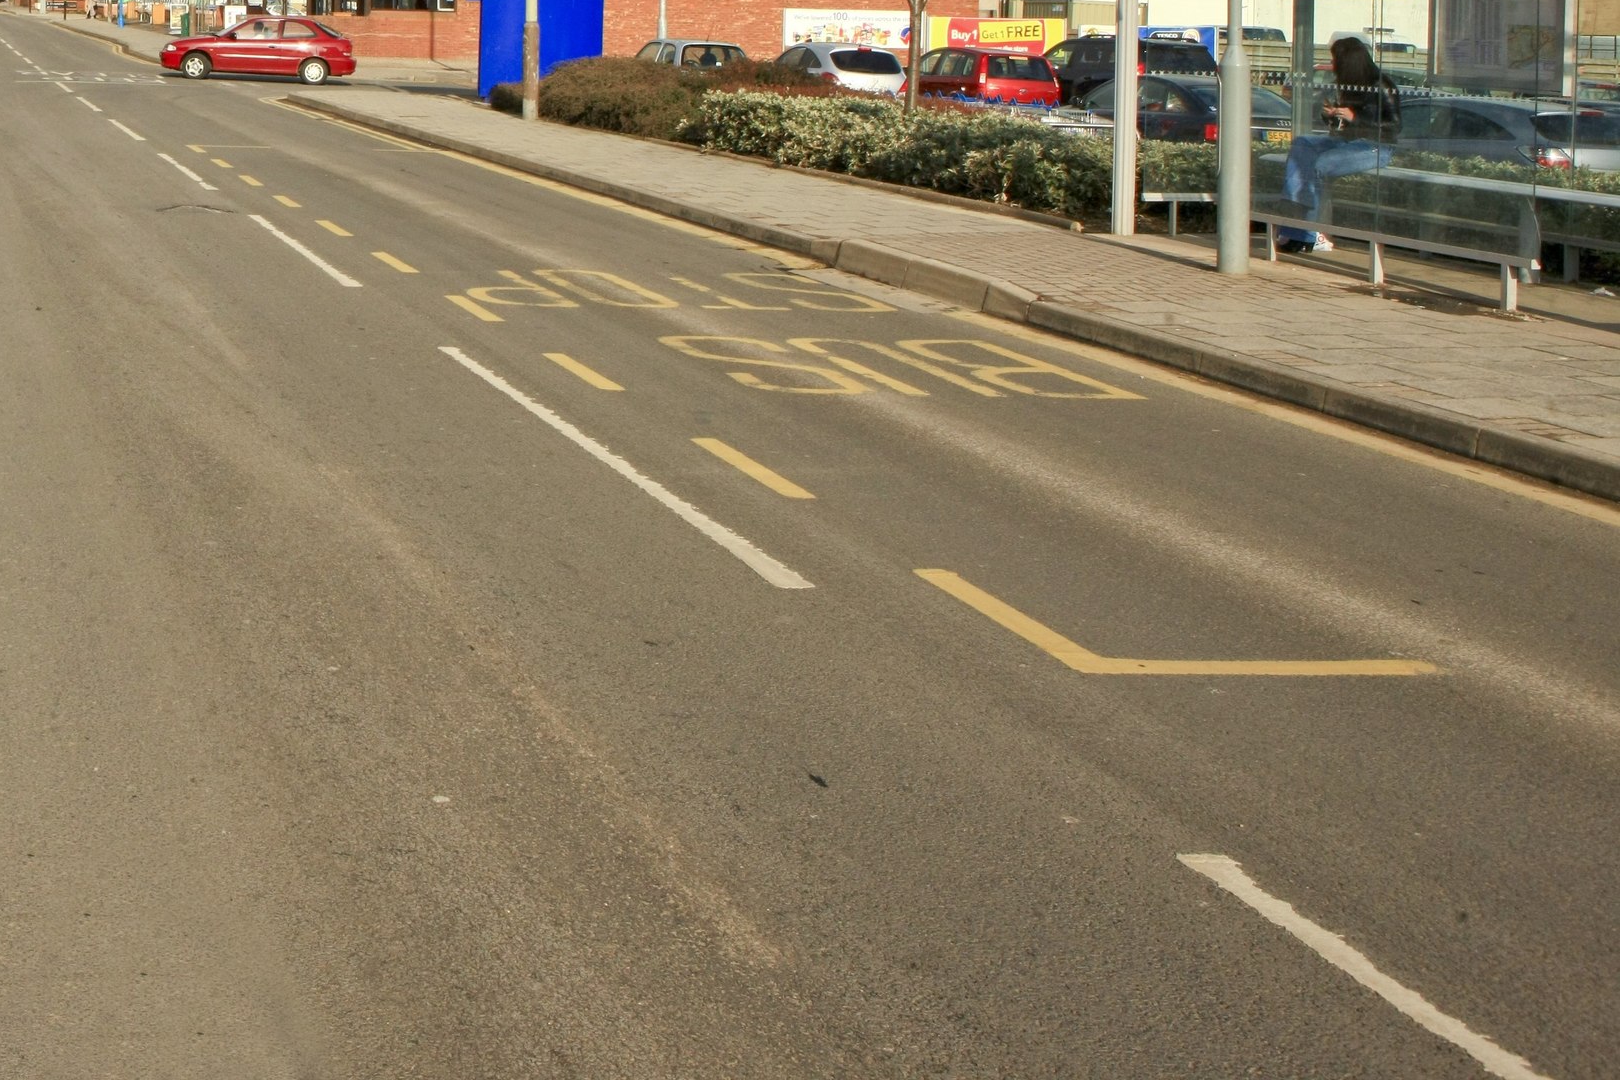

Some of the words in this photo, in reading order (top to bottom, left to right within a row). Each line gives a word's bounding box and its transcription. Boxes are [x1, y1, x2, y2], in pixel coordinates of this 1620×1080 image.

[951, 29, 971, 42] Buy
[972, 29, 978, 39] 1
[982, 30, 999, 39] Get
[1001, 30, 1005, 38] 1
[1006, 25, 1041, 38] FREE
[466, 269, 898, 313] STOP
[658, 335, 1148, 401] BUS
